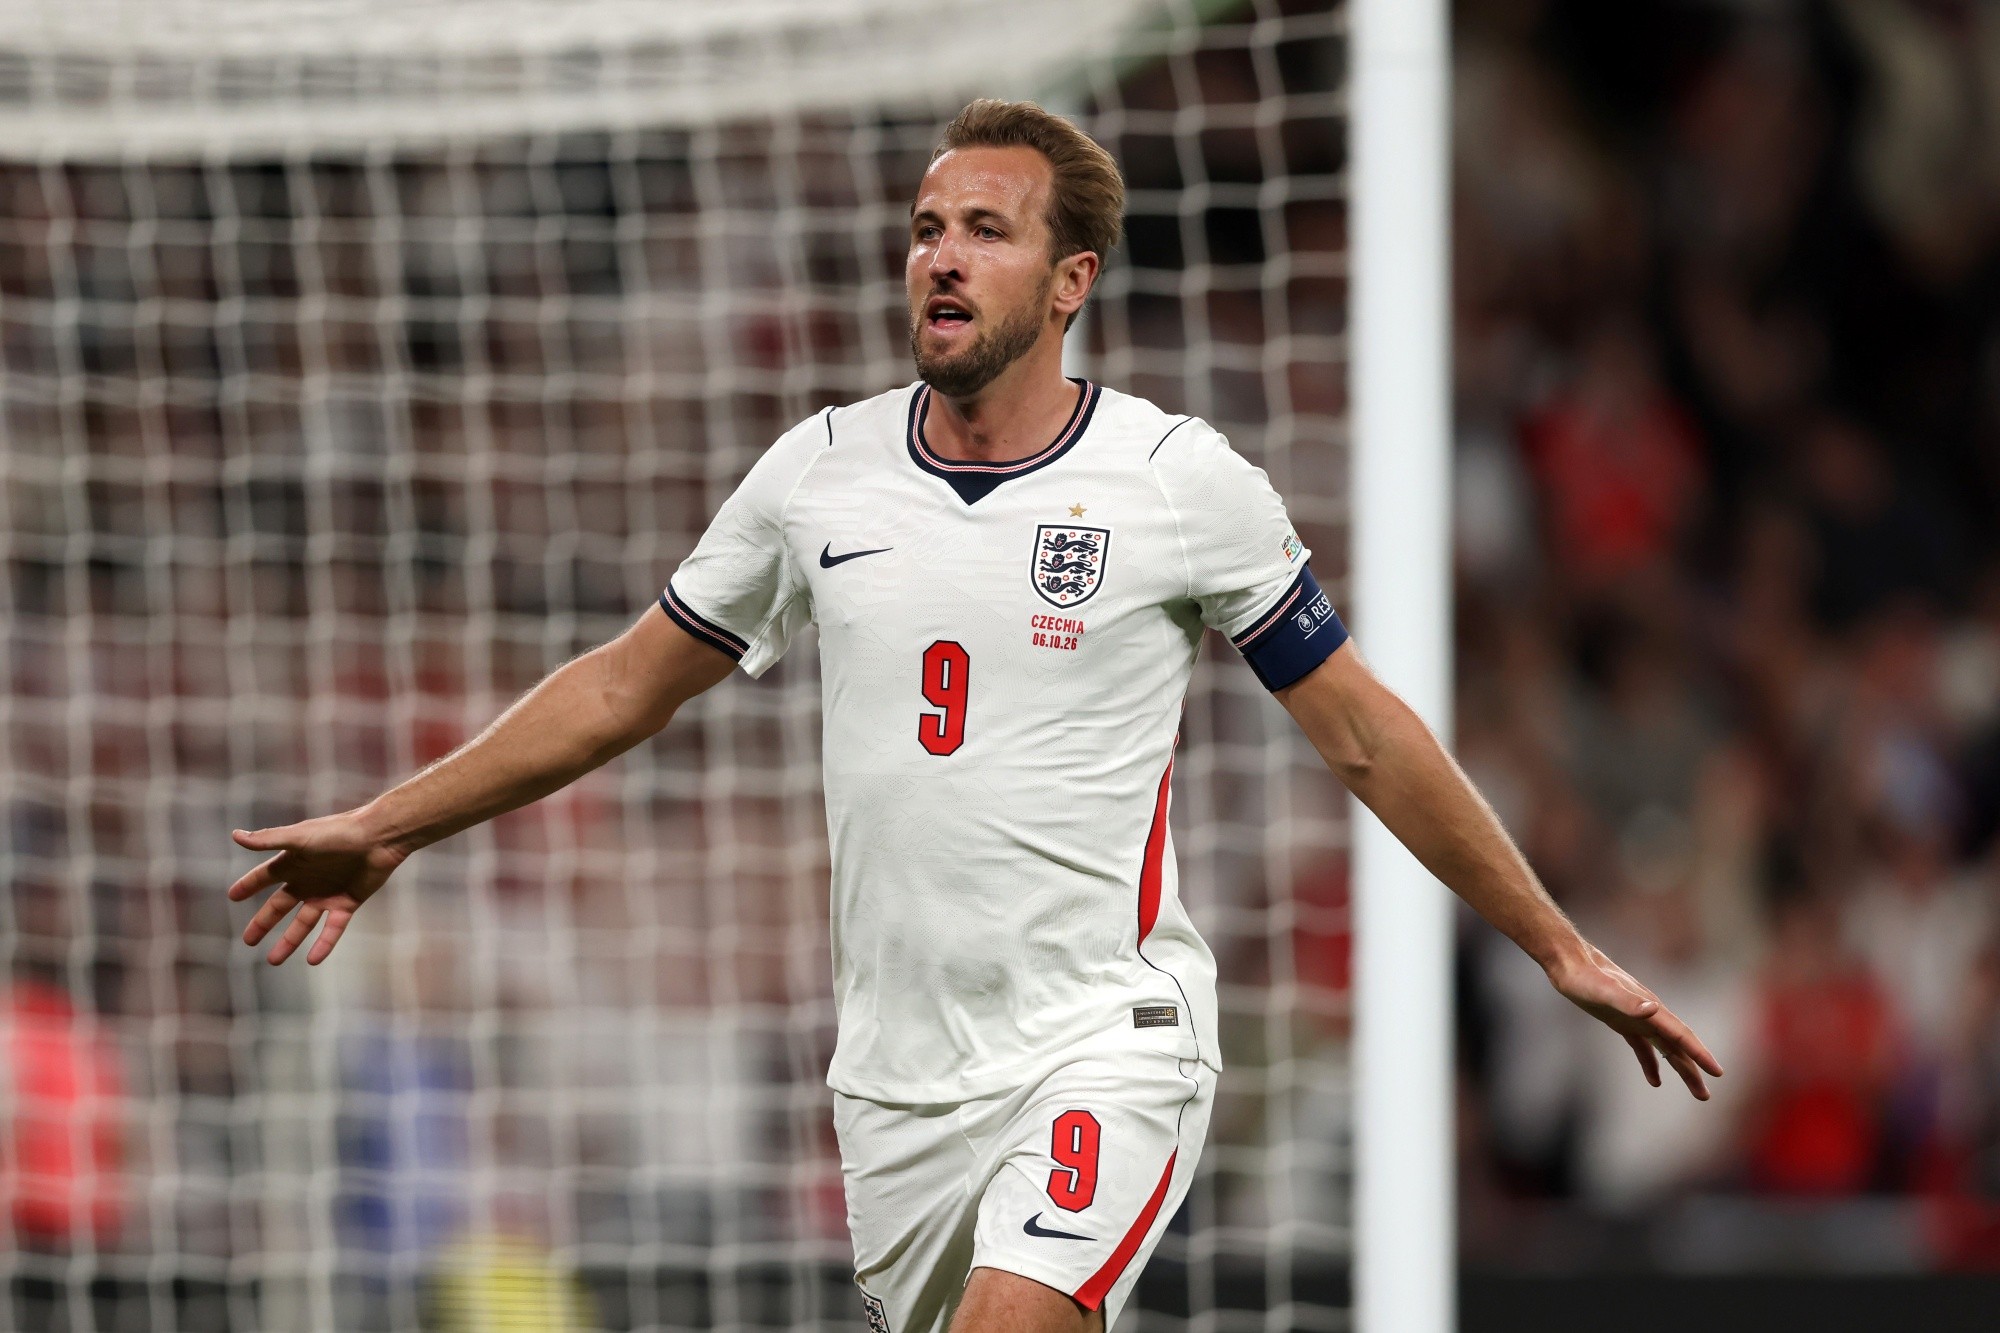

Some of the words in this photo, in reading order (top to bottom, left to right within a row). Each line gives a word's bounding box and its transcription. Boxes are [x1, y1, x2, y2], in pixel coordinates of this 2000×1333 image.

[1311, 594, 1332, 620] RES
[1031, 614, 1084, 634] CZECHIA
[1032, 632, 1078, 650] 06.10.26
[918, 640, 970, 757] 9
[1046, 1109, 1102, 1213] 9
